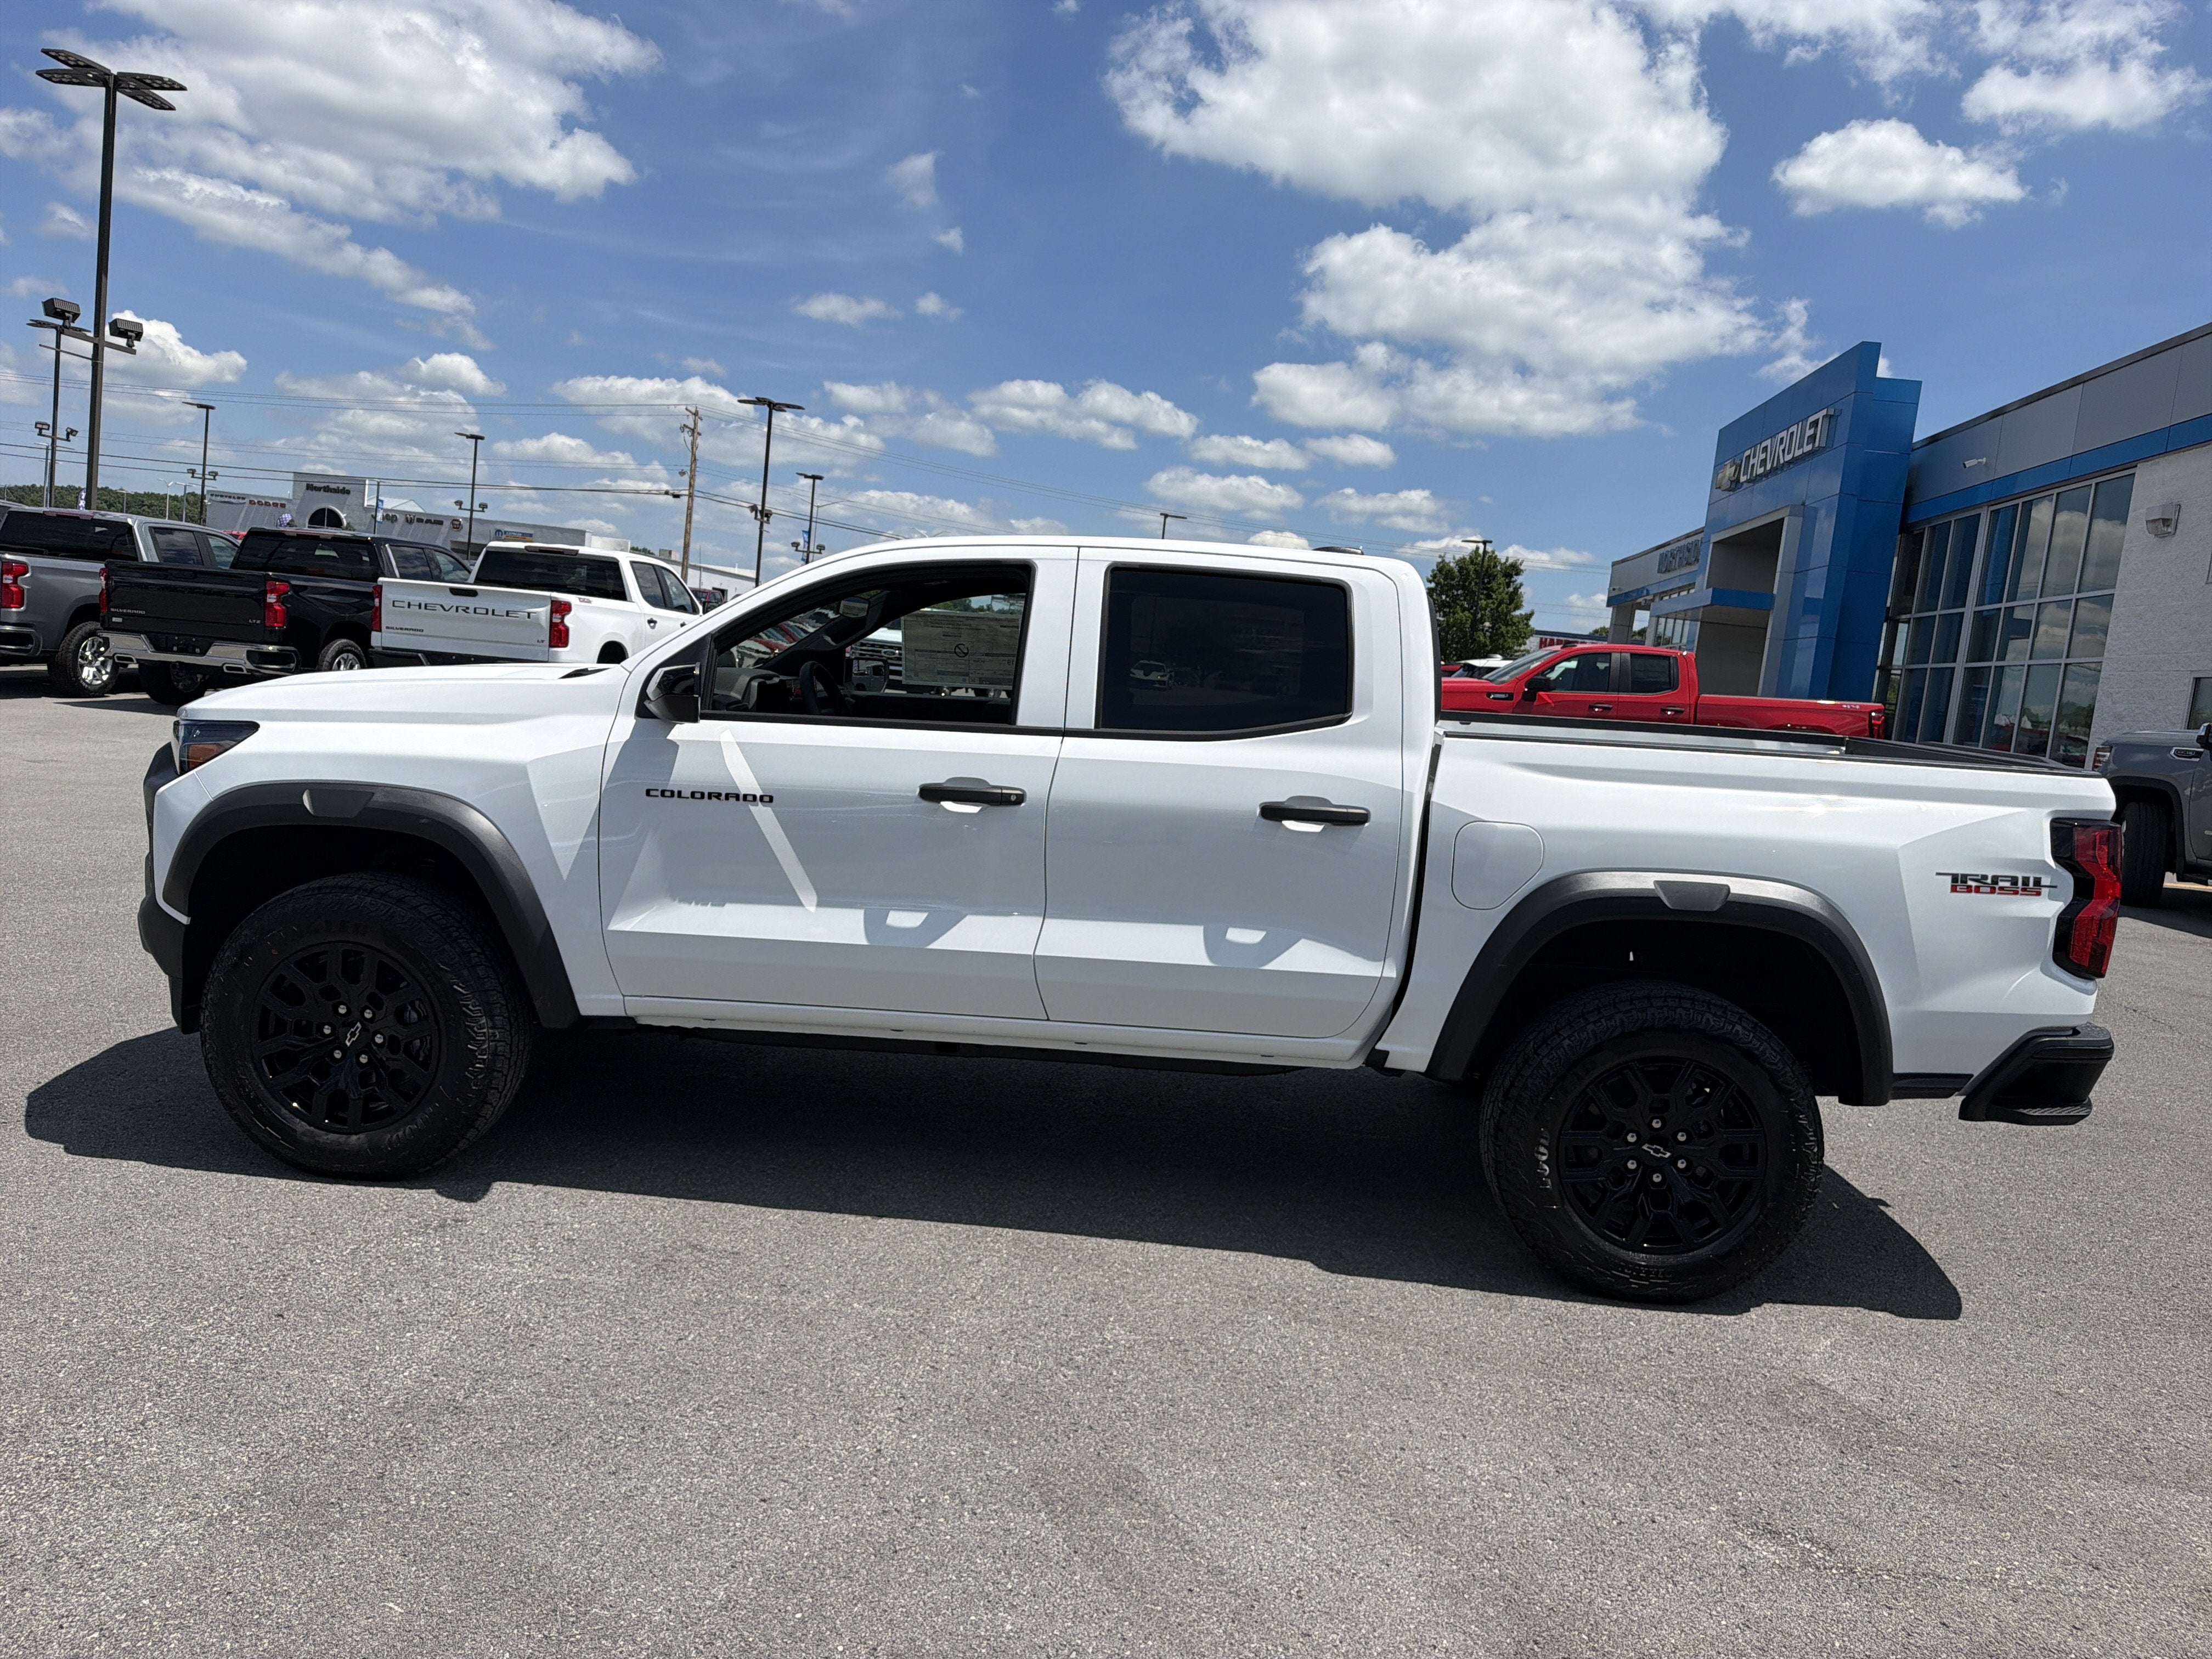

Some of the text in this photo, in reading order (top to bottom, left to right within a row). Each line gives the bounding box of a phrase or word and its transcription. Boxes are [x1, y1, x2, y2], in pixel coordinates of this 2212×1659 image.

[1740, 408, 1830, 483] CHEVROLET
[306, 483, 351, 495] Northside
[249, 499, 286, 508] DODGE
[392, 600, 537, 619] CHEVROLET
[645, 788, 774, 803] COLORADO
[1936, 872, 2058, 889] TRAIL
[1950, 884, 2042, 896] BOSS
